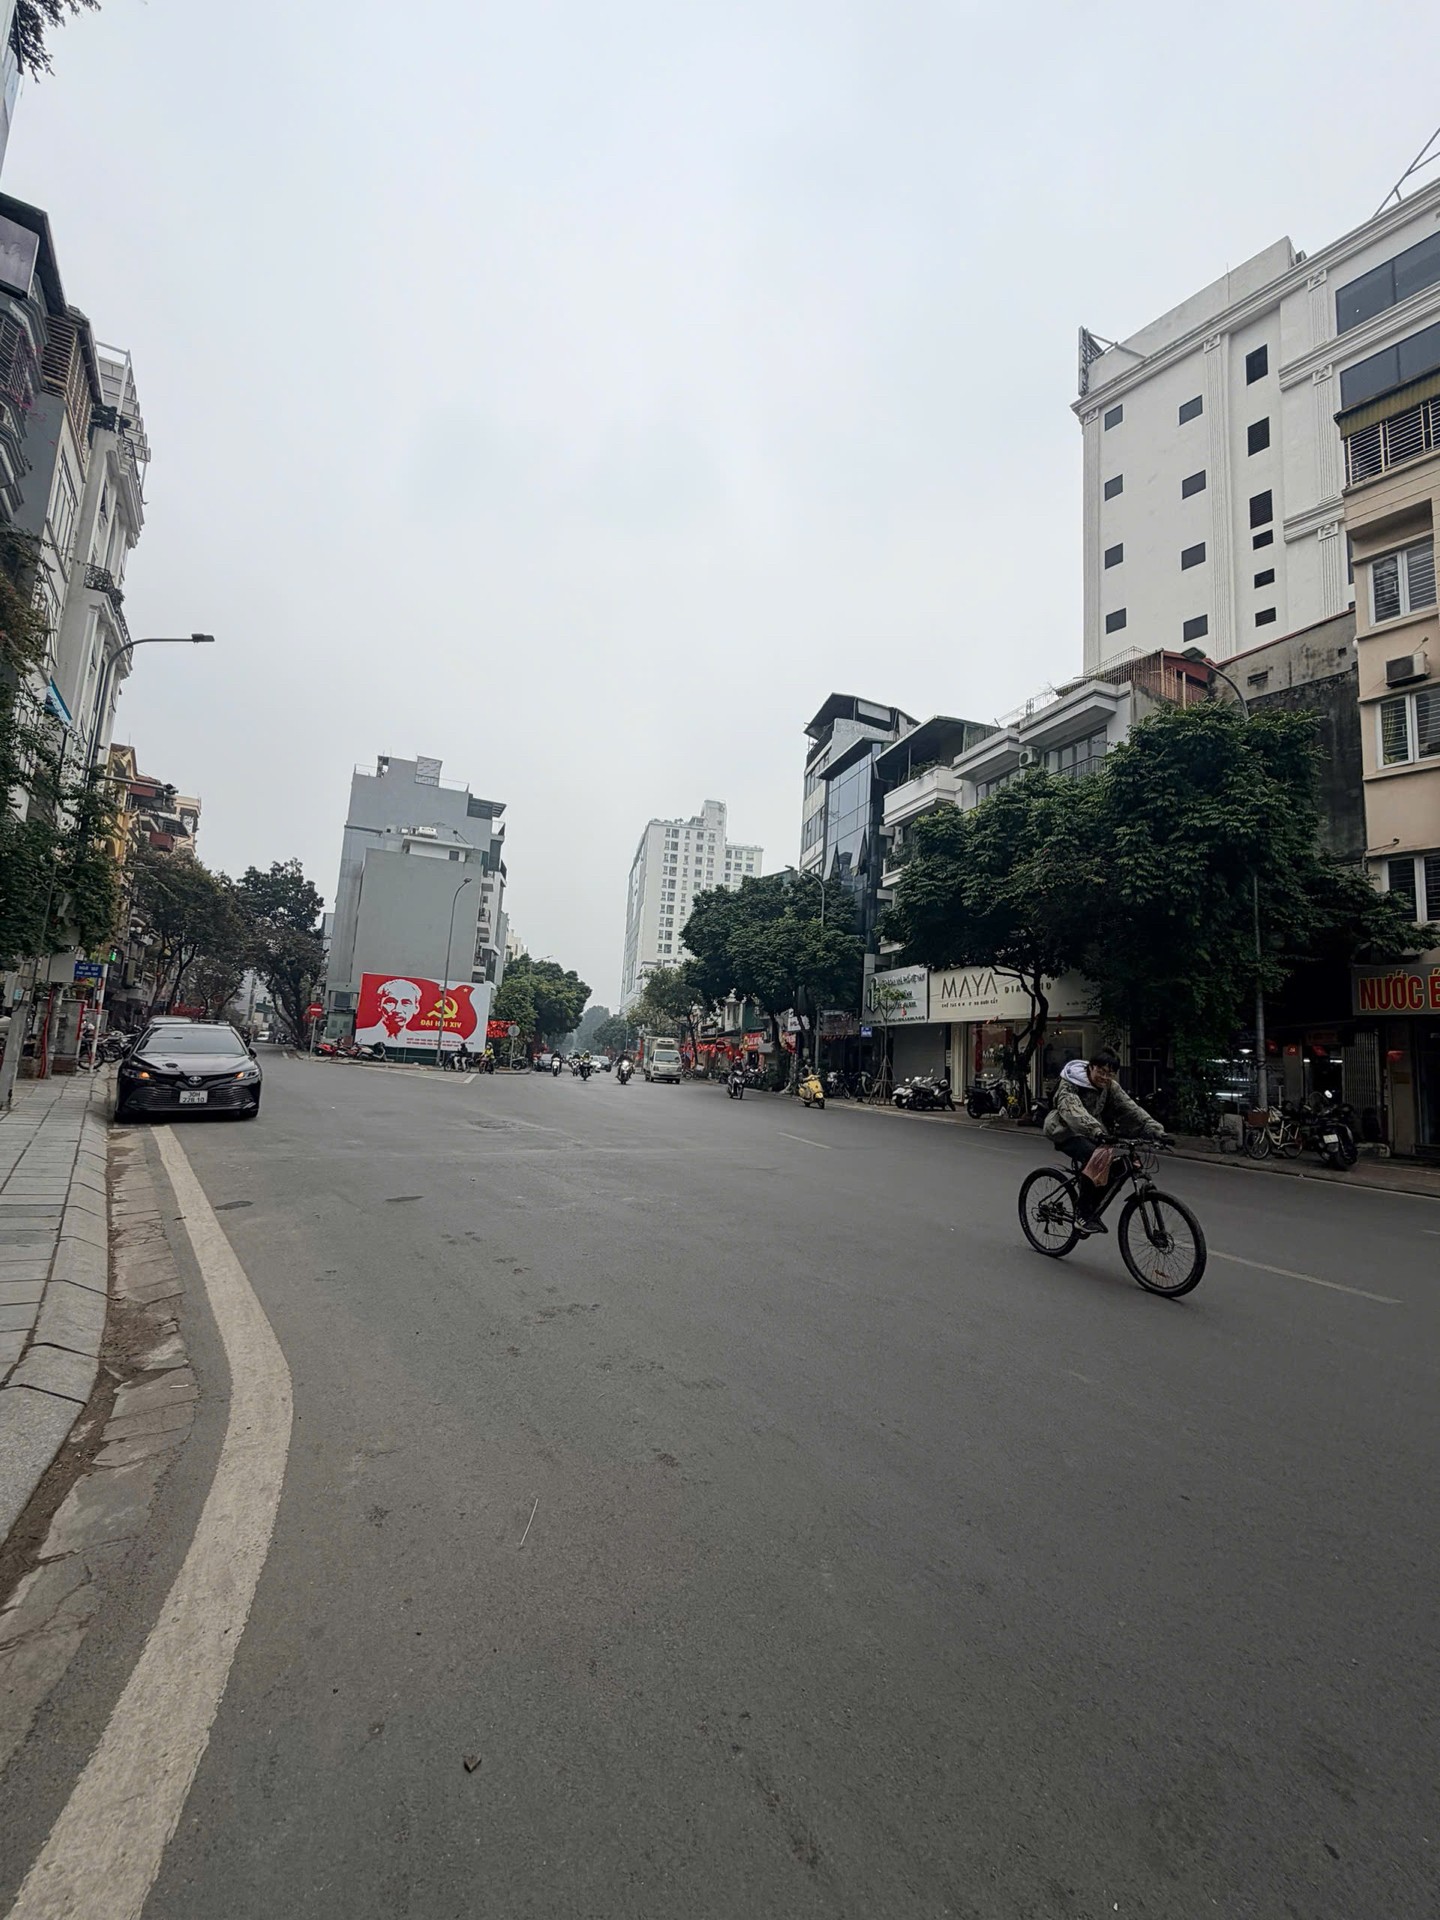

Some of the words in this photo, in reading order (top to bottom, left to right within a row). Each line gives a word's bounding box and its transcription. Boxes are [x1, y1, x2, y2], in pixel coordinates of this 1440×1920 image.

[942, 972, 998, 999] MAYA
[1359, 969, 1425, 1010] NƯỚC
[1428, 967, 1440, 1009] É
[420, 1019, 434, 1028] ĐẠI
[449, 1021, 462, 1029] XIV
